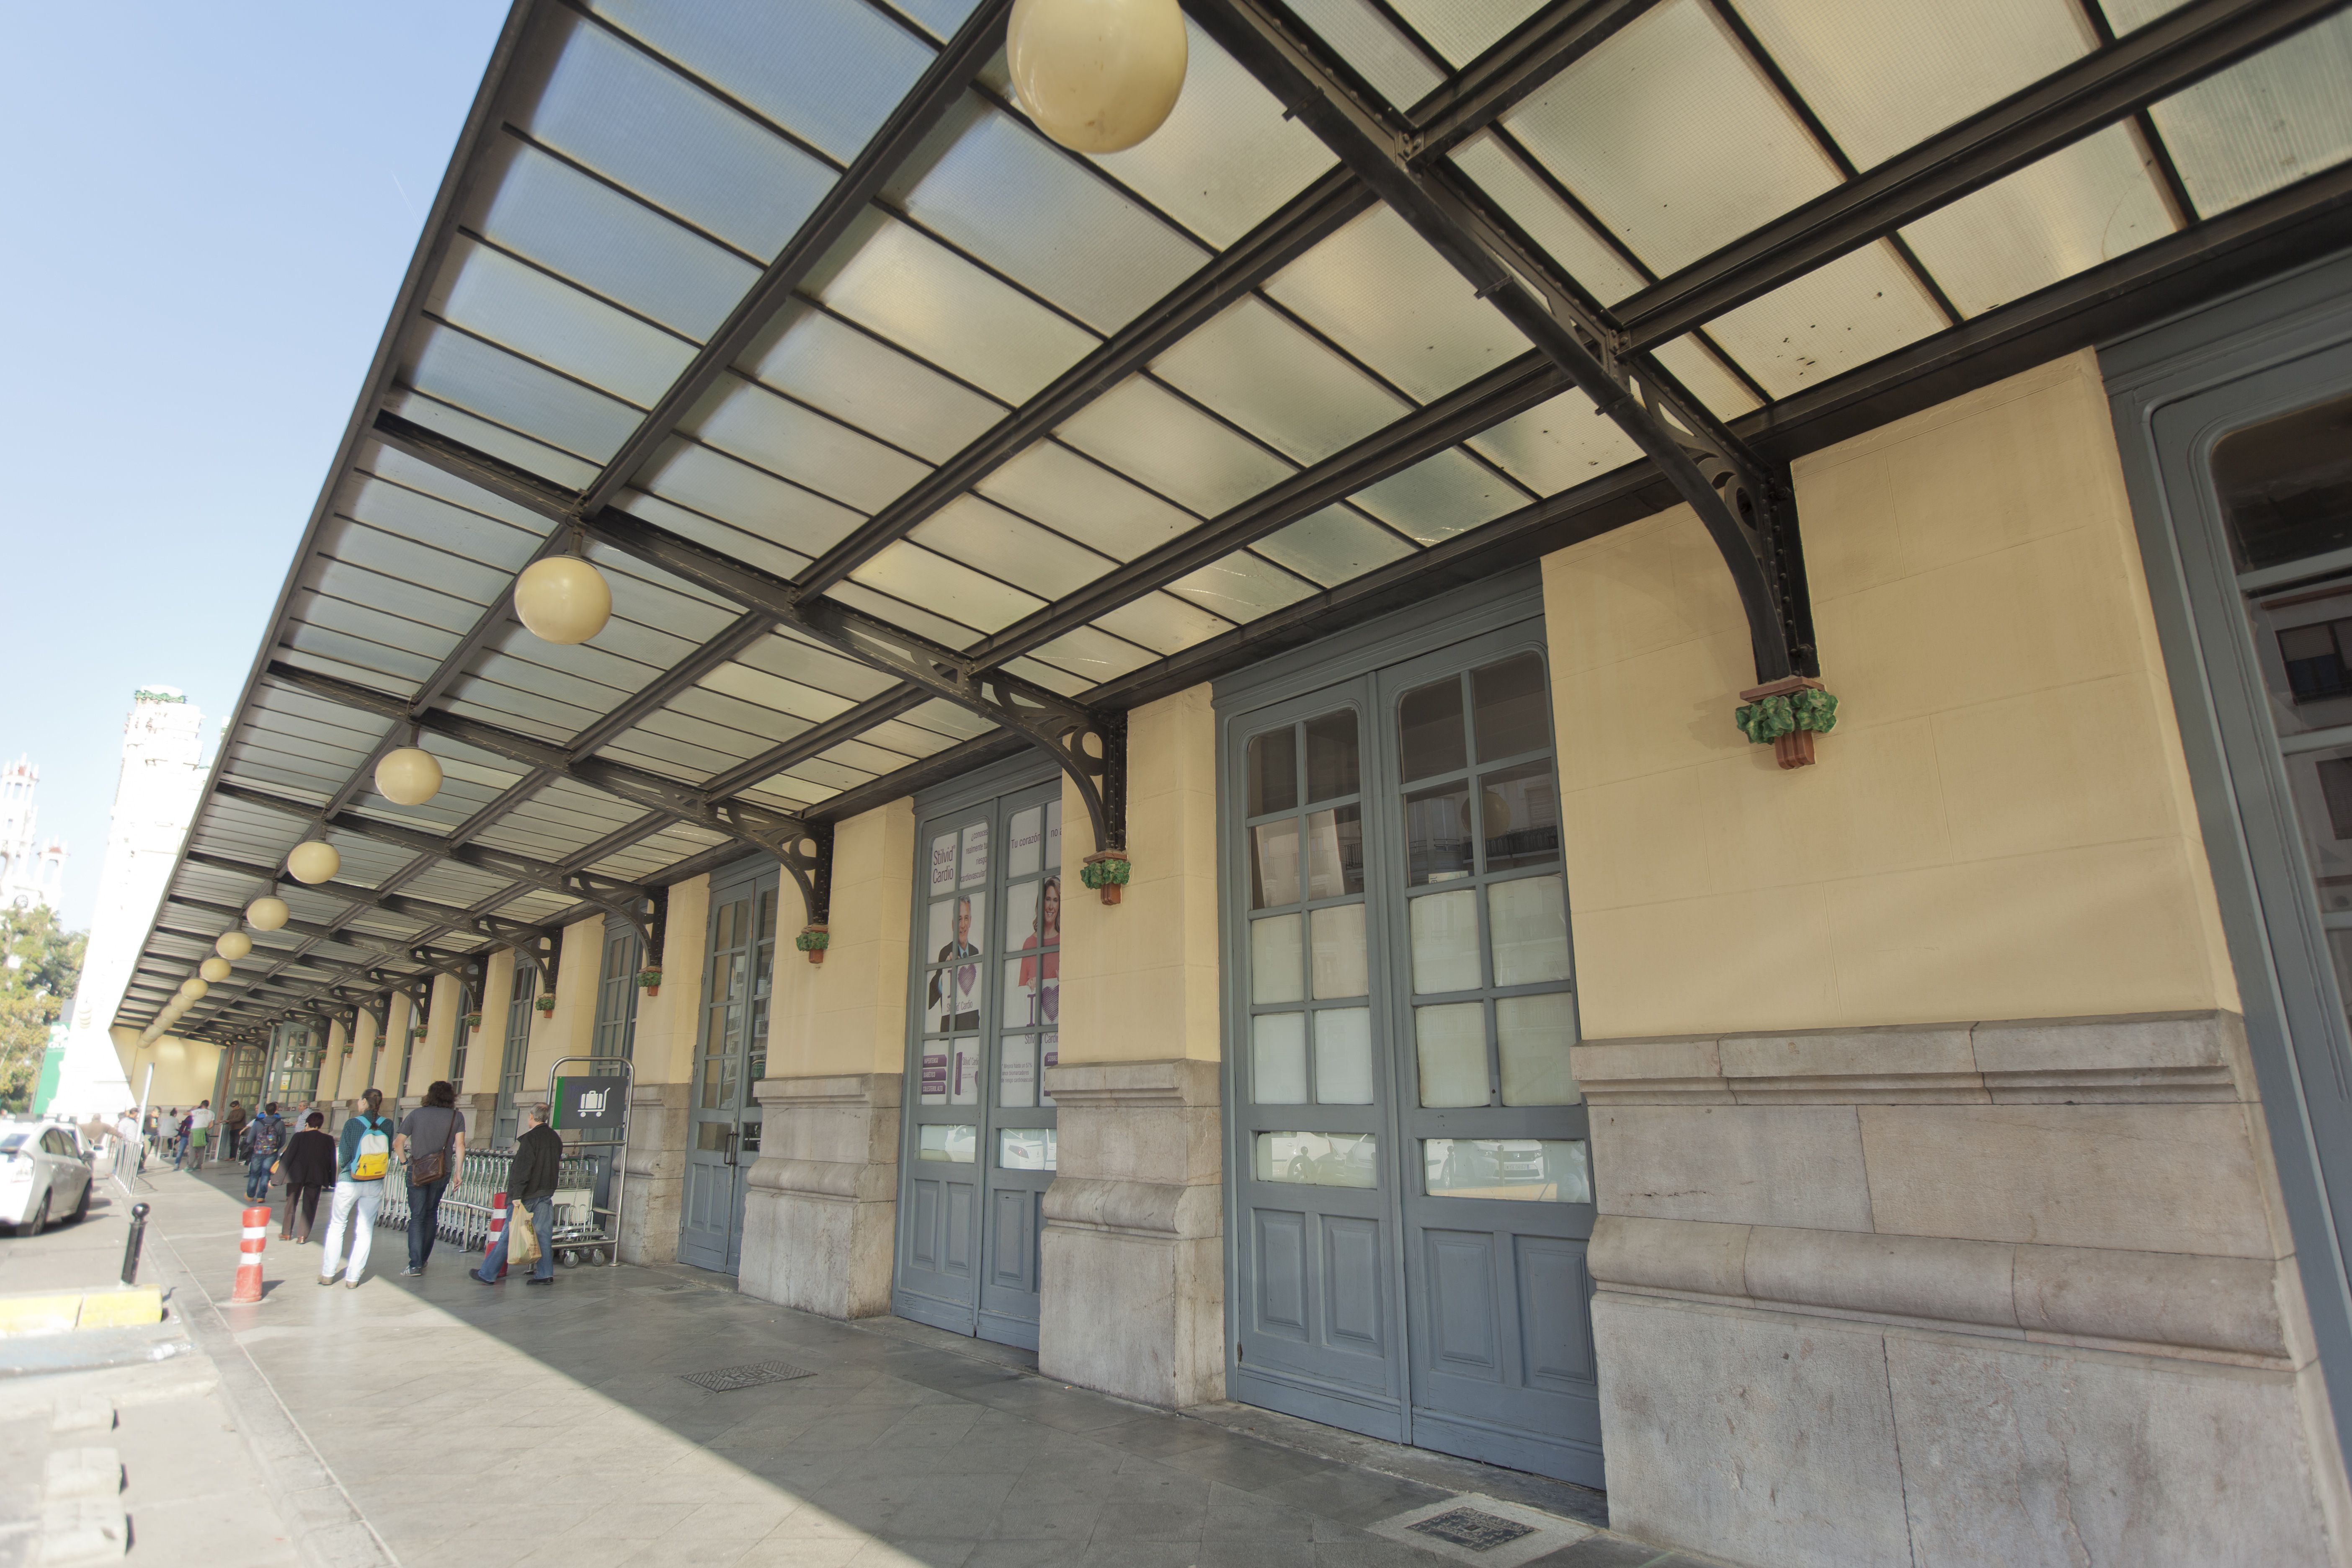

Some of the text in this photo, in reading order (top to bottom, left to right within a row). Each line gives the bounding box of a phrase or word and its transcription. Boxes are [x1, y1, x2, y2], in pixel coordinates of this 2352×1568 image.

[1011, 839, 1018, 848] Tu
[1051, 829, 1058, 838] no
[965, 843, 983, 854] realmente
[976, 856, 987, 865] riesgo
[933, 865, 954, 884] Cardio
[961, 1000, 973, 1010] Cardio
[1026, 993, 1036, 1027] I
[1024, 1033, 1035, 1044] Stilv
